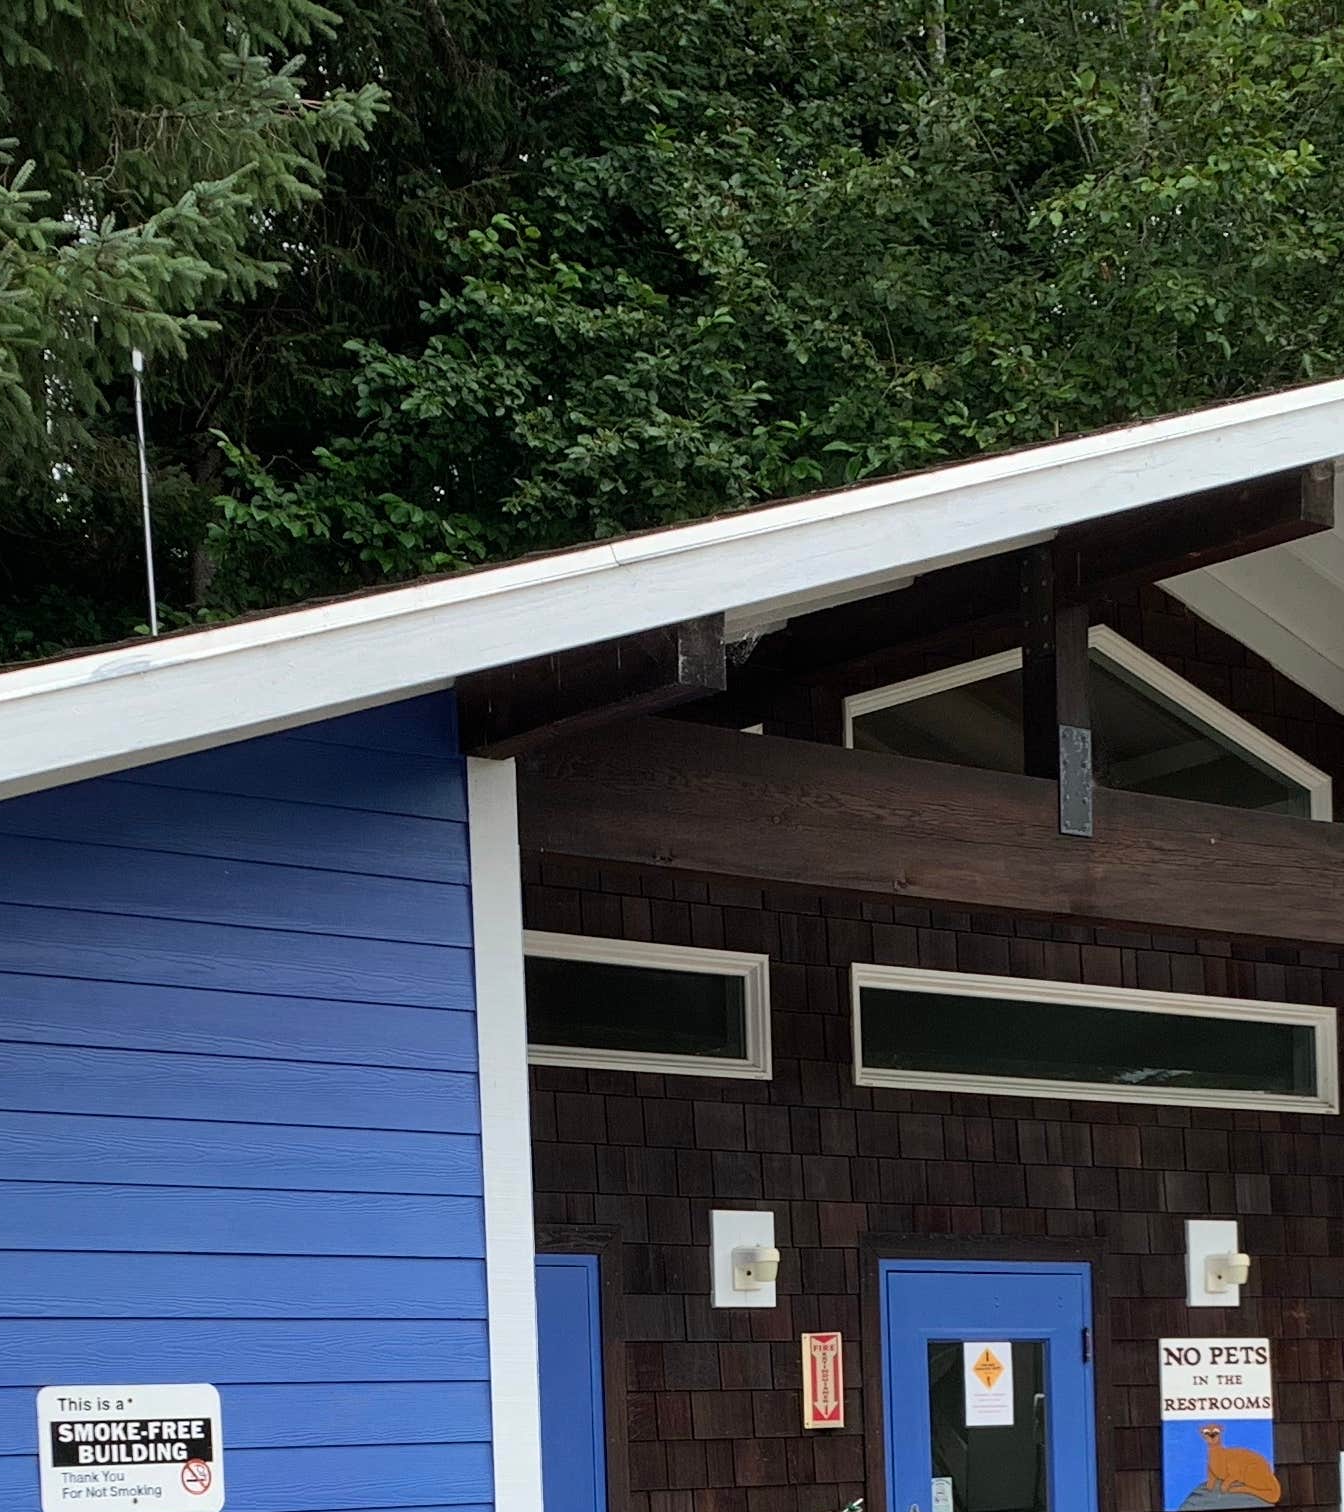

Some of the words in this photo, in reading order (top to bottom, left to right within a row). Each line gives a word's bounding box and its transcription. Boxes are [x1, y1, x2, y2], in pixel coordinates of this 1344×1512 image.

[813, 1344, 834, 1352] FIRE
[1164, 1347, 1201, 1366] NO
[1209, 1347, 1267, 1365] PETS
[1193, 1376, 1208, 1385] IN
[1216, 1375, 1242, 1385] THE
[57, 1398, 92, 1412] This
[97, 1397, 110, 1411] is
[115, 1400, 124, 1410] a
[1164, 1397, 1271, 1411] RESTROOMS
[58, 1420, 205, 1442] SMOKE-FREE
[78, 1443, 188, 1464] BUILDING
[62, 1473, 99, 1483] Thank
[103, 1471, 125, 1481] You
[62, 1487, 82, 1499] For
[86, 1485, 107, 1497] Not
[109, 1485, 162, 1497] Smoking
